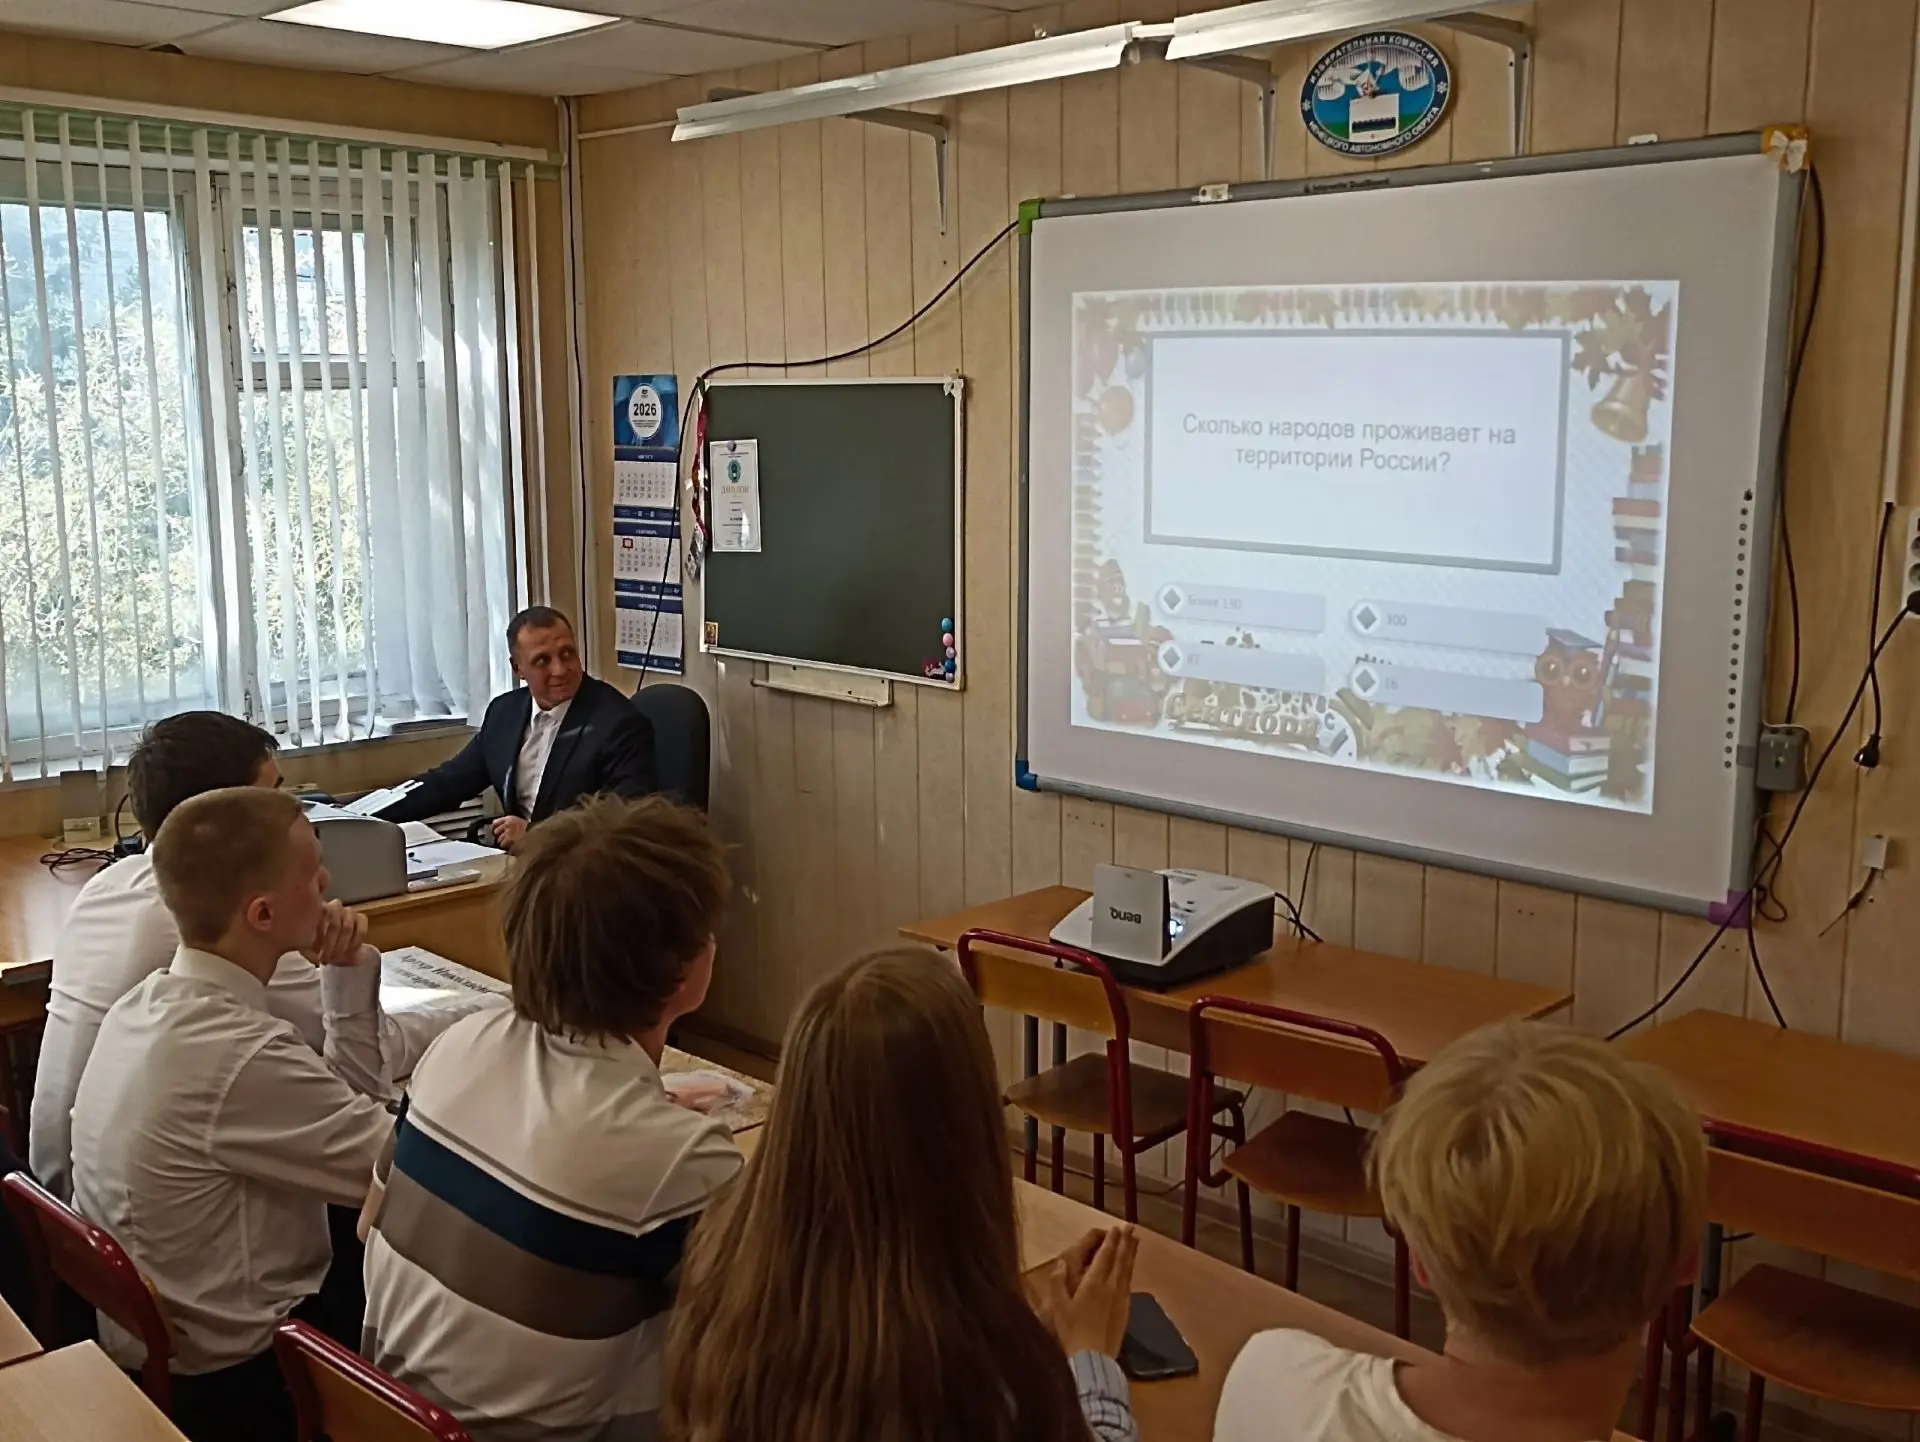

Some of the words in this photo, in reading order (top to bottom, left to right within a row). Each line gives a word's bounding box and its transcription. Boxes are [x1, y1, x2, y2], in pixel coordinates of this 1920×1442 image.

[1309, 34, 1385, 83] ИЗБИРАТЕЛЬНАЯ
[1389, 35, 1440, 68] КОМИССИЯ
[1309, 120, 1348, 151] НЕНЕЦКОГО
[1350, 133, 1411, 153] АВТОНОМНОГО
[1411, 106, 1440, 136] ОКРУГА
[633, 403, 656, 416] 2026
[1183, 412, 1263, 435] Сколько
[1269, 420, 1355, 441] народов
[1362, 423, 1481, 444] проживает
[1489, 427, 1516, 444] на
[1235, 448, 1352, 472] территории
[1360, 447, 1451, 472] России?
[1109, 906, 1142, 924] BenQ
